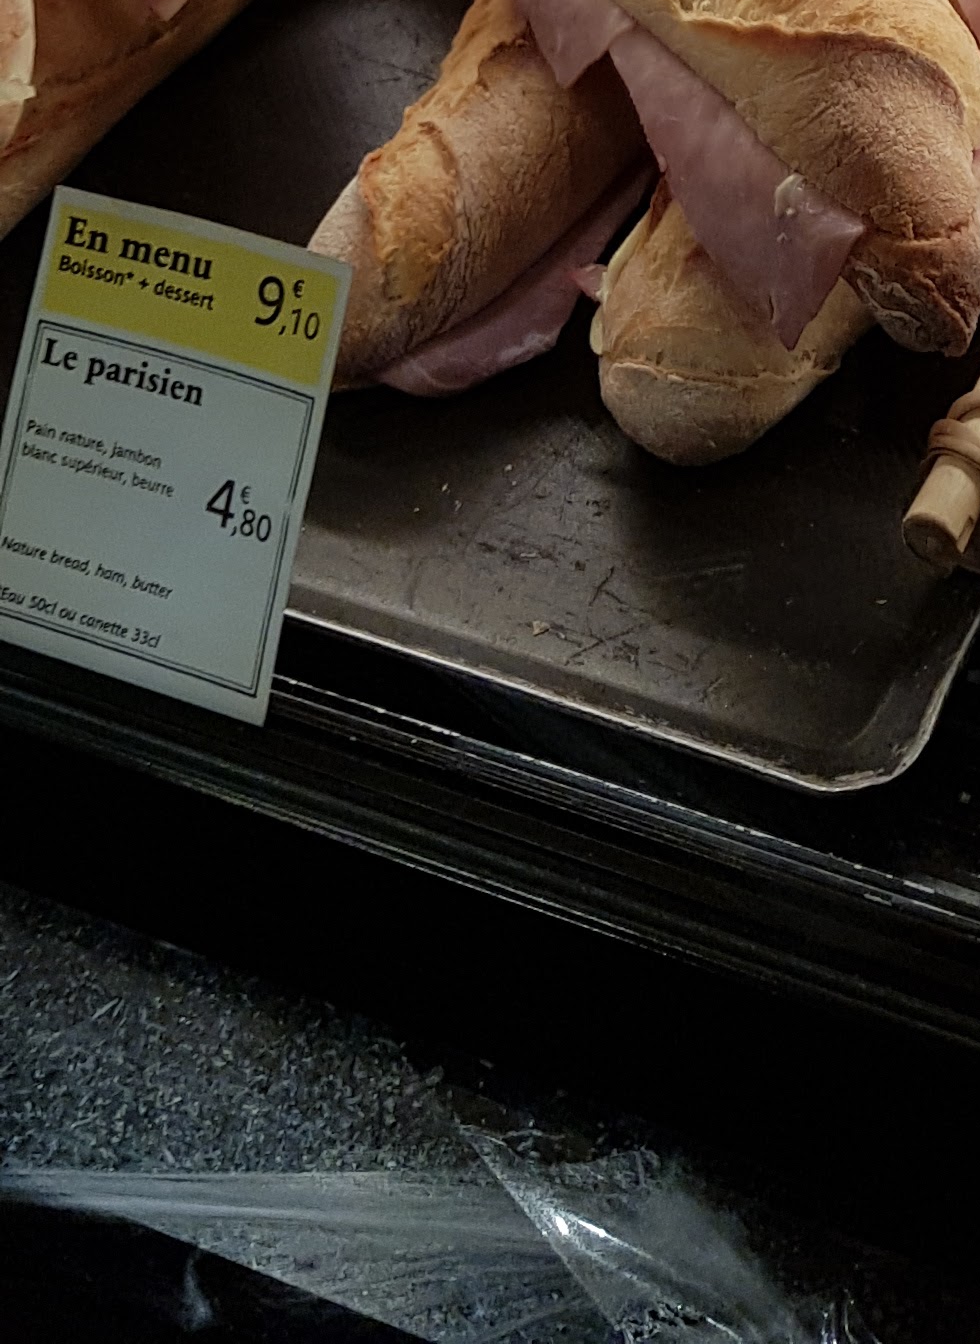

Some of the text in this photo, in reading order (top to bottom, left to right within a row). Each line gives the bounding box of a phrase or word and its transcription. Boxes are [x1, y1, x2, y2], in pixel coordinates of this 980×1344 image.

[64, 216, 213, 280] En menu
[153, 279, 214, 310] dessert
[41, 337, 204, 406] Le parisien
[21, 441, 174, 498] blanc supérieur, beurre
[26, 419, 162, 469] Pain nature, jambon
[0, 536, 174, 600] Nature bread, ham, butter
[28, 595, 59, 616] 50cl
[59, 607, 78, 622] ou
[80, 614, 128, 639] canette
[131, 628, 162, 649] 33cl
